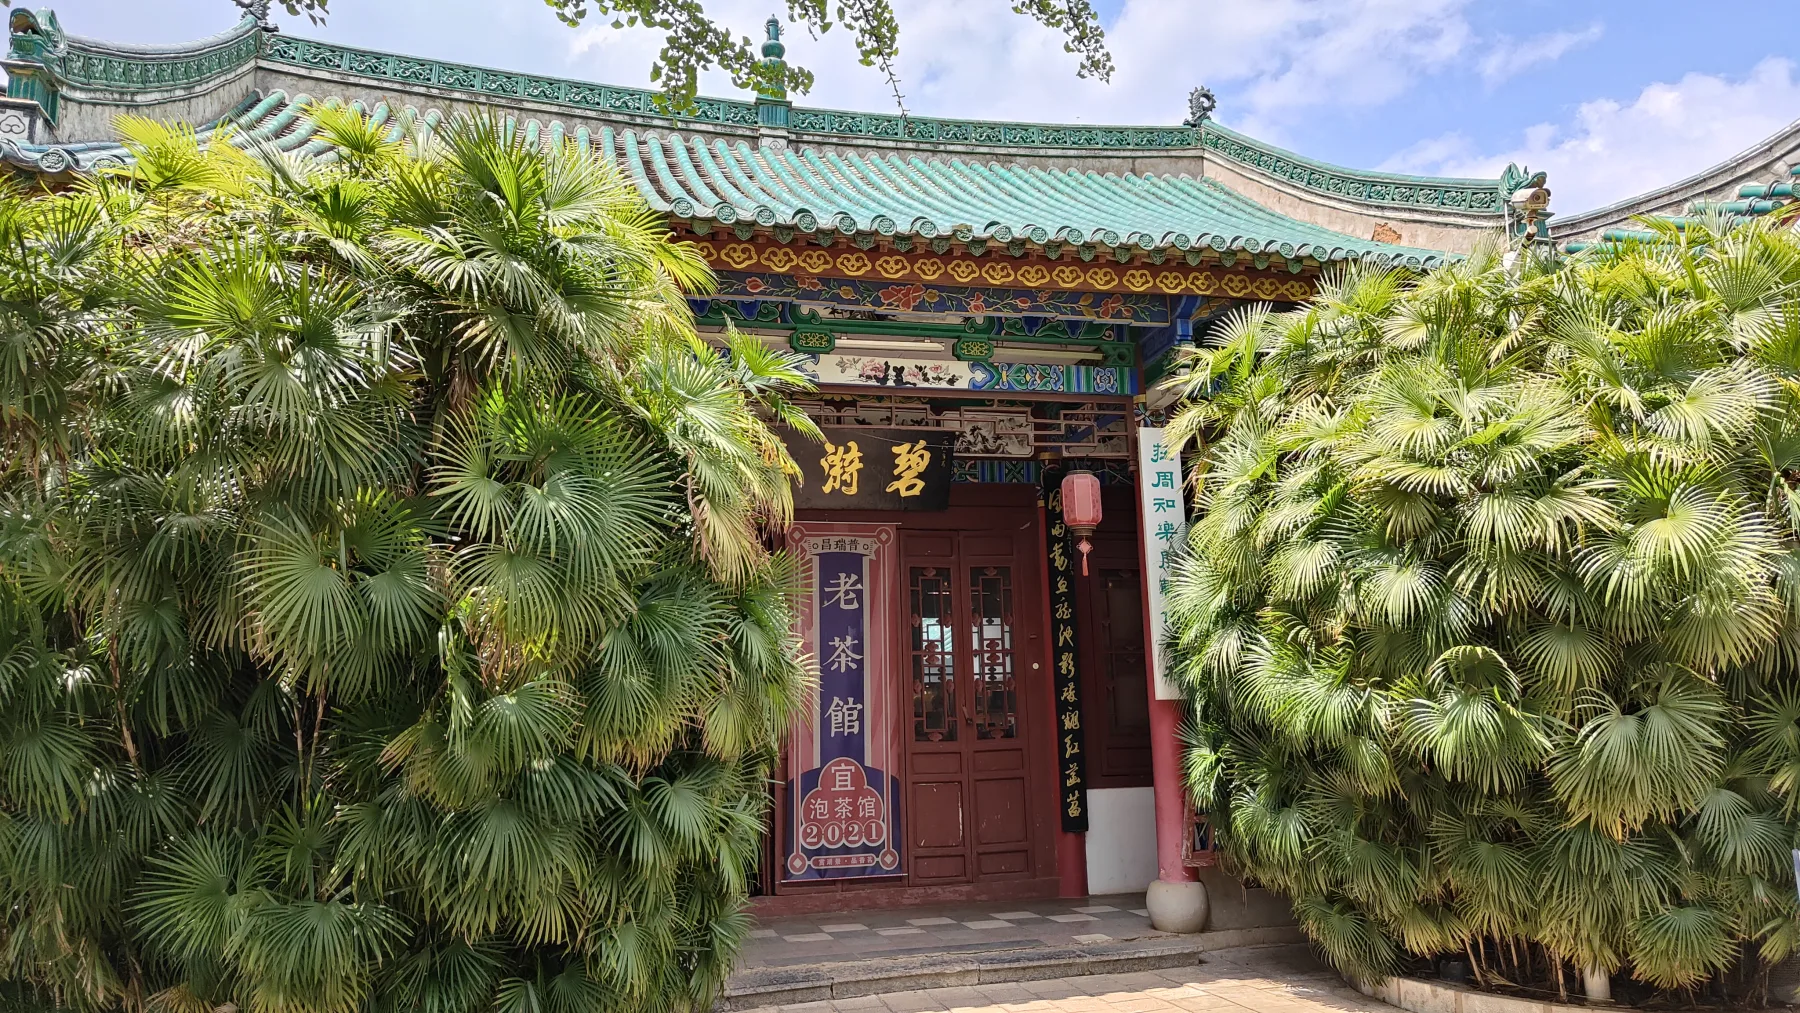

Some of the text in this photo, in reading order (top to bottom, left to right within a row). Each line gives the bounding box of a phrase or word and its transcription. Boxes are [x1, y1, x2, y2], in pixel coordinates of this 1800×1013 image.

[822, 572, 863, 738] 老茶館
[830, 763, 855, 791] 宜
[809, 796, 876, 819] 泡茶馆
[806, 823, 878, 842] 2021
